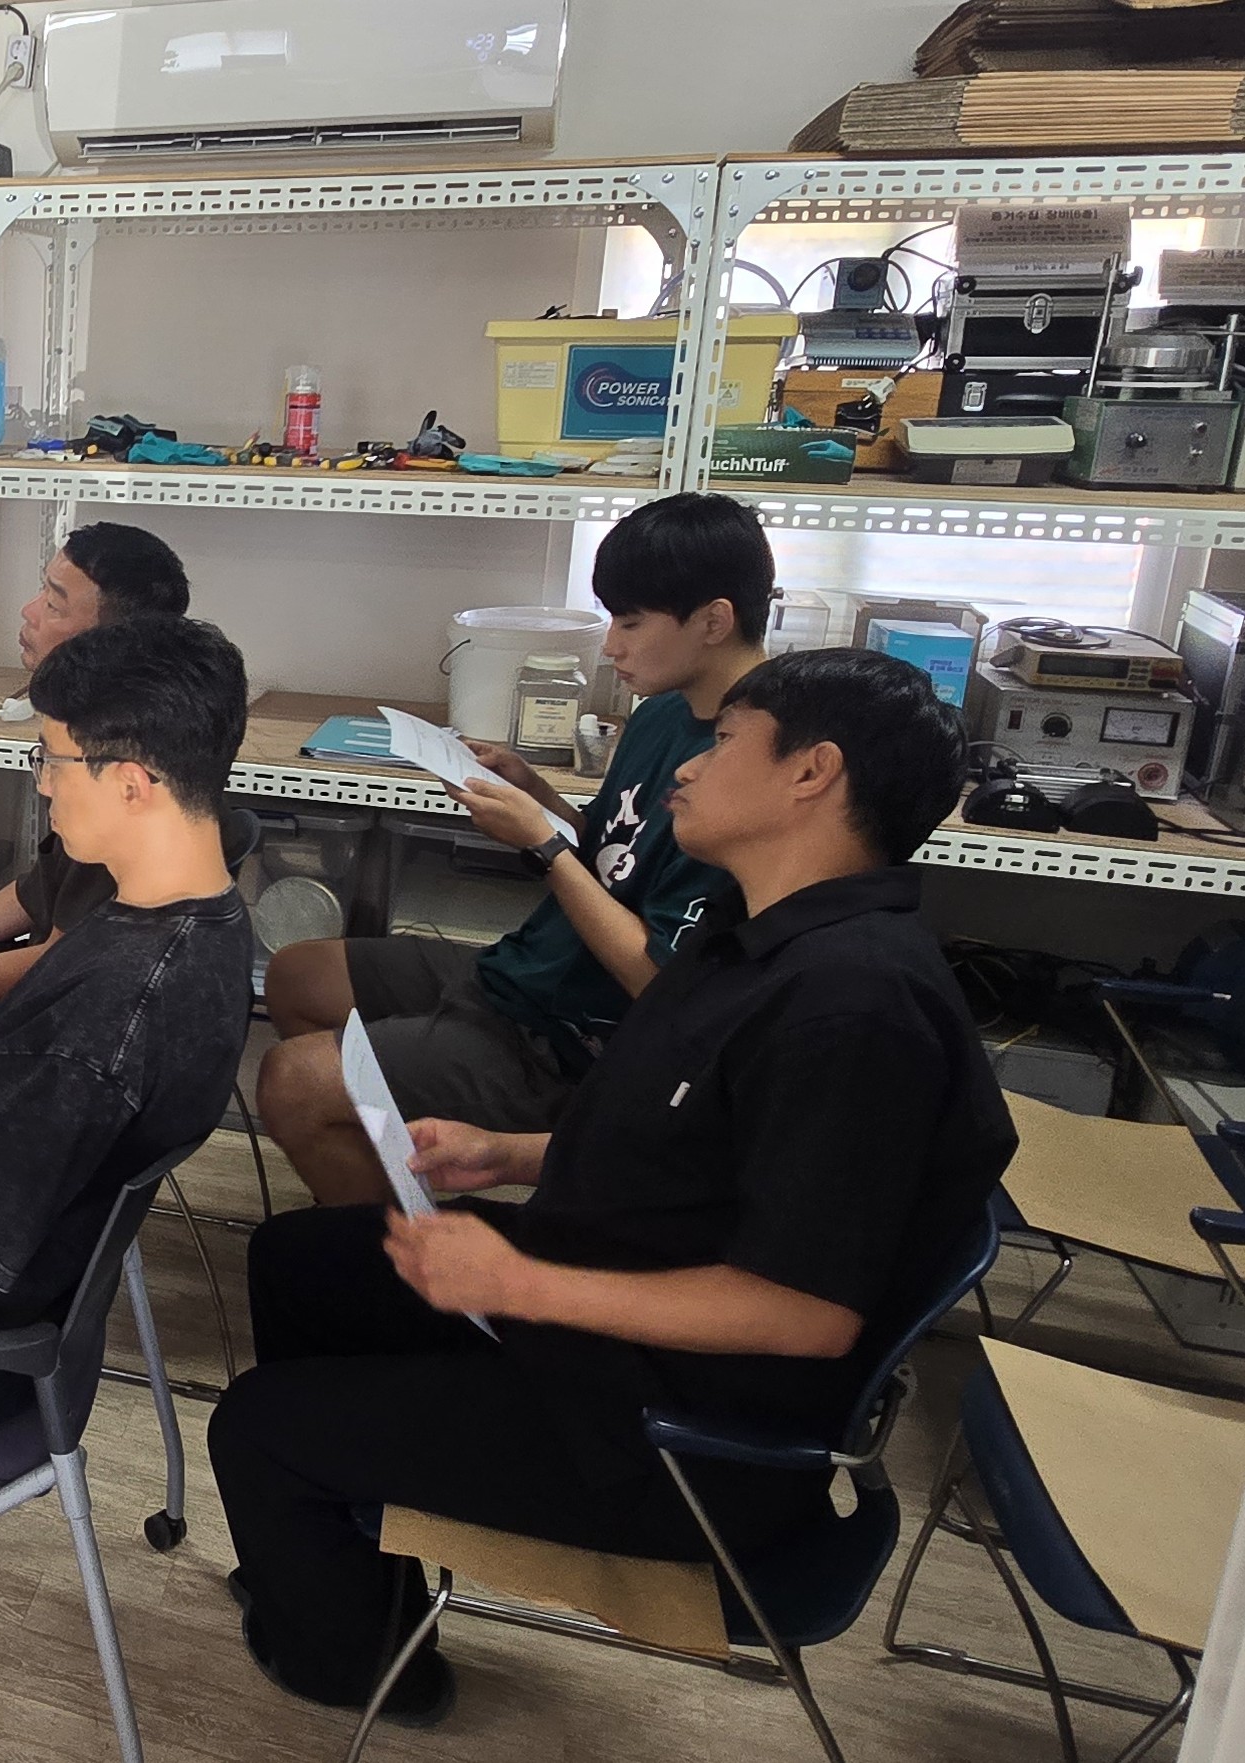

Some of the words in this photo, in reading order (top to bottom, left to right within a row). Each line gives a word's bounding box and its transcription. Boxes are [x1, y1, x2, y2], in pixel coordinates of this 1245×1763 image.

[473, 33, 495, 50] 23
[597, 382, 660, 395] POWER
[616, 395, 671, 407] SONIC4
[710, 457, 787, 472] uchNTuff
